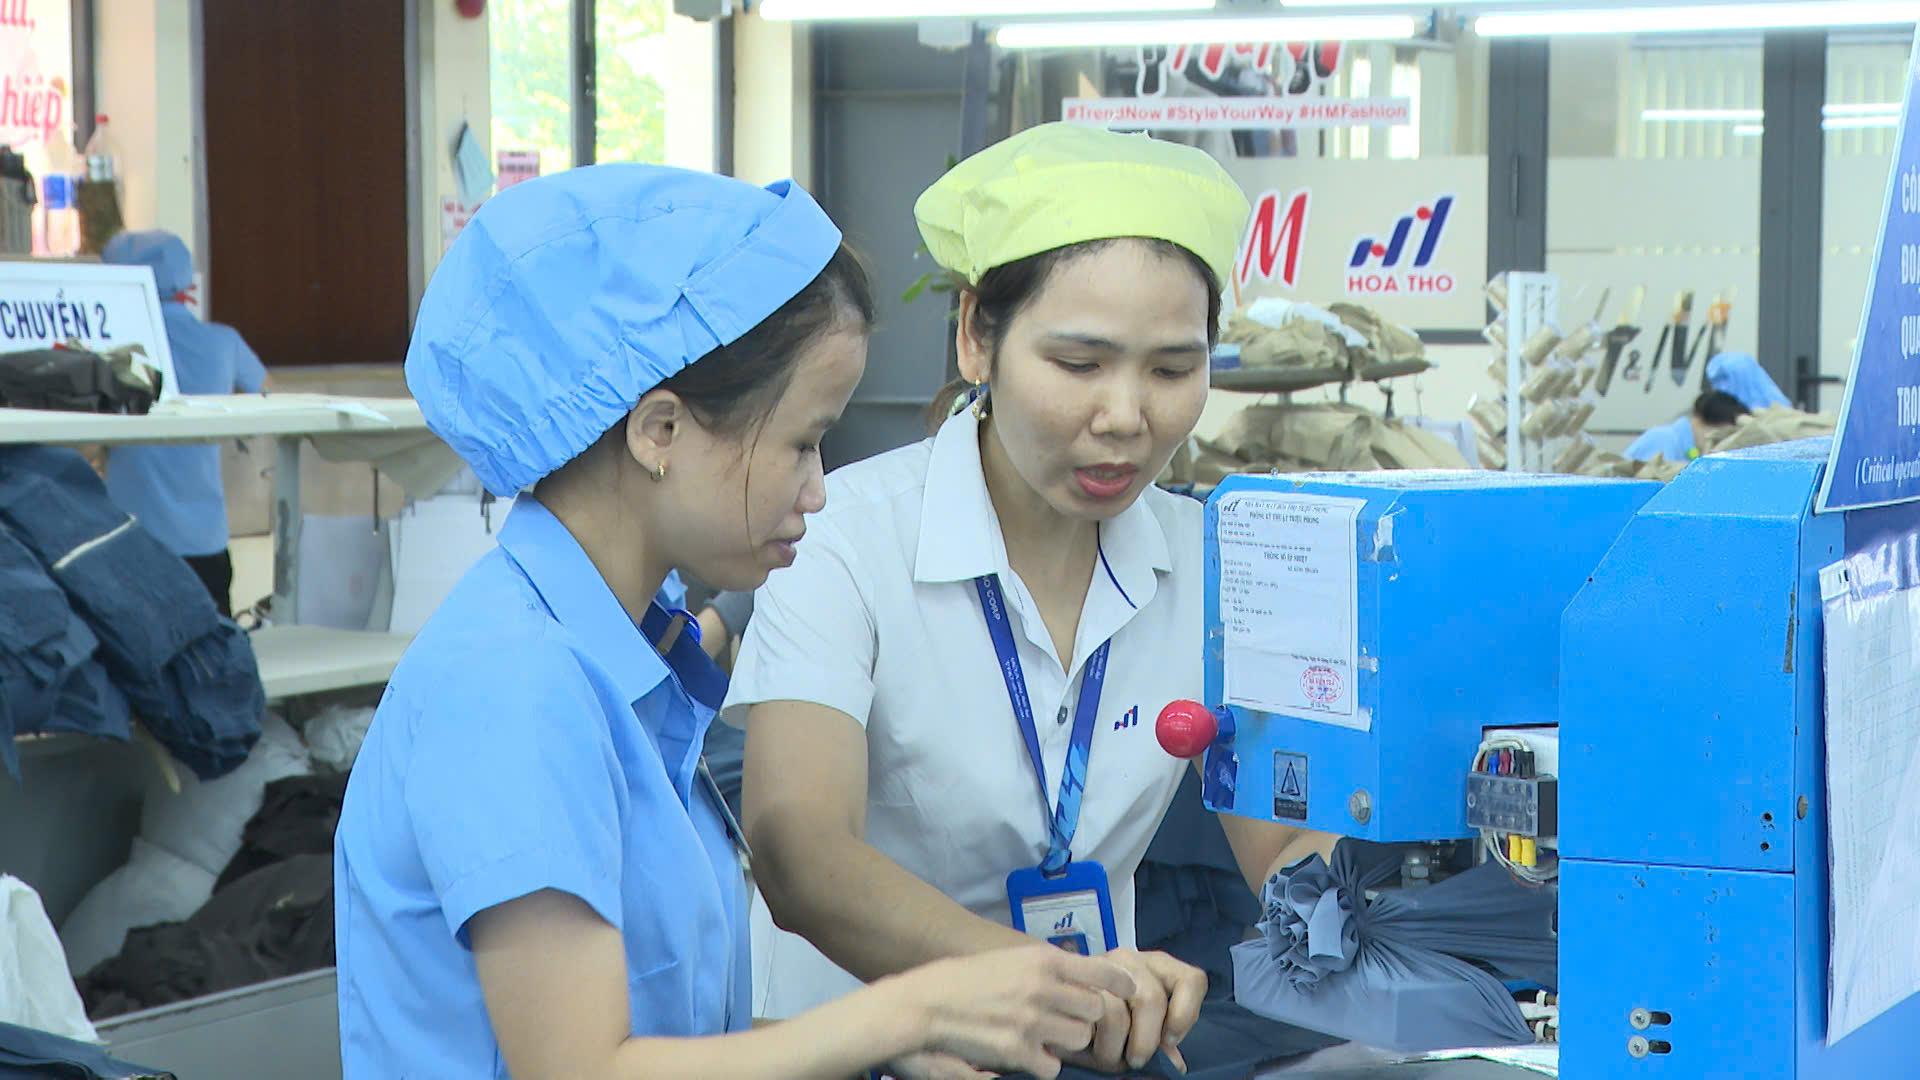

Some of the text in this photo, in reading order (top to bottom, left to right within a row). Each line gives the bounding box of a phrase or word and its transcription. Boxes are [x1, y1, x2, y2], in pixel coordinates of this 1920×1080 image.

[1066, 104, 1407, 124] #TrendNow #StyleYourWay #HMFashion
[1348, 275, 1454, 293] HOA THO
[95, 302, 112, 339] 2
